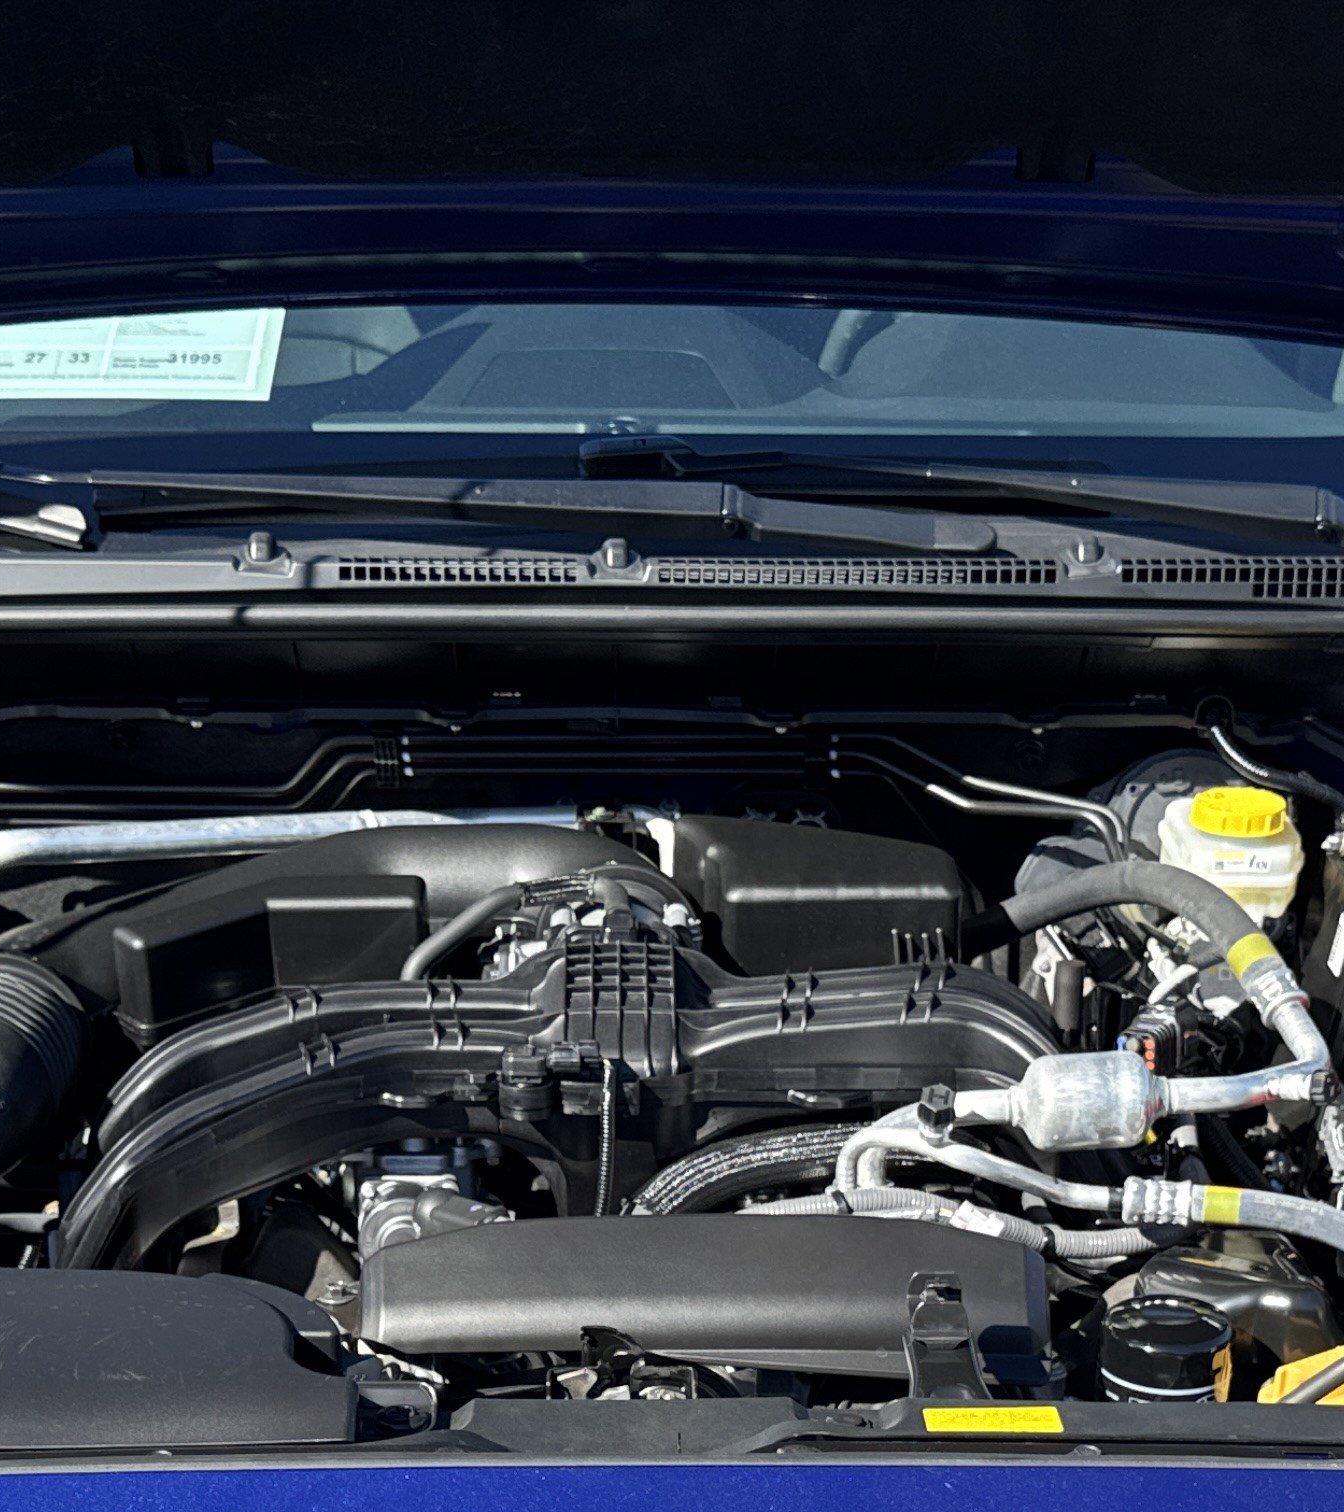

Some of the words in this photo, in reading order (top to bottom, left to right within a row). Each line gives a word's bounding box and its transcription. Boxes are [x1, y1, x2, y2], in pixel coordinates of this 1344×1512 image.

[24, 352, 47, 364] 27
[68, 352, 91, 364] 33
[169, 353, 223, 365] 31995
